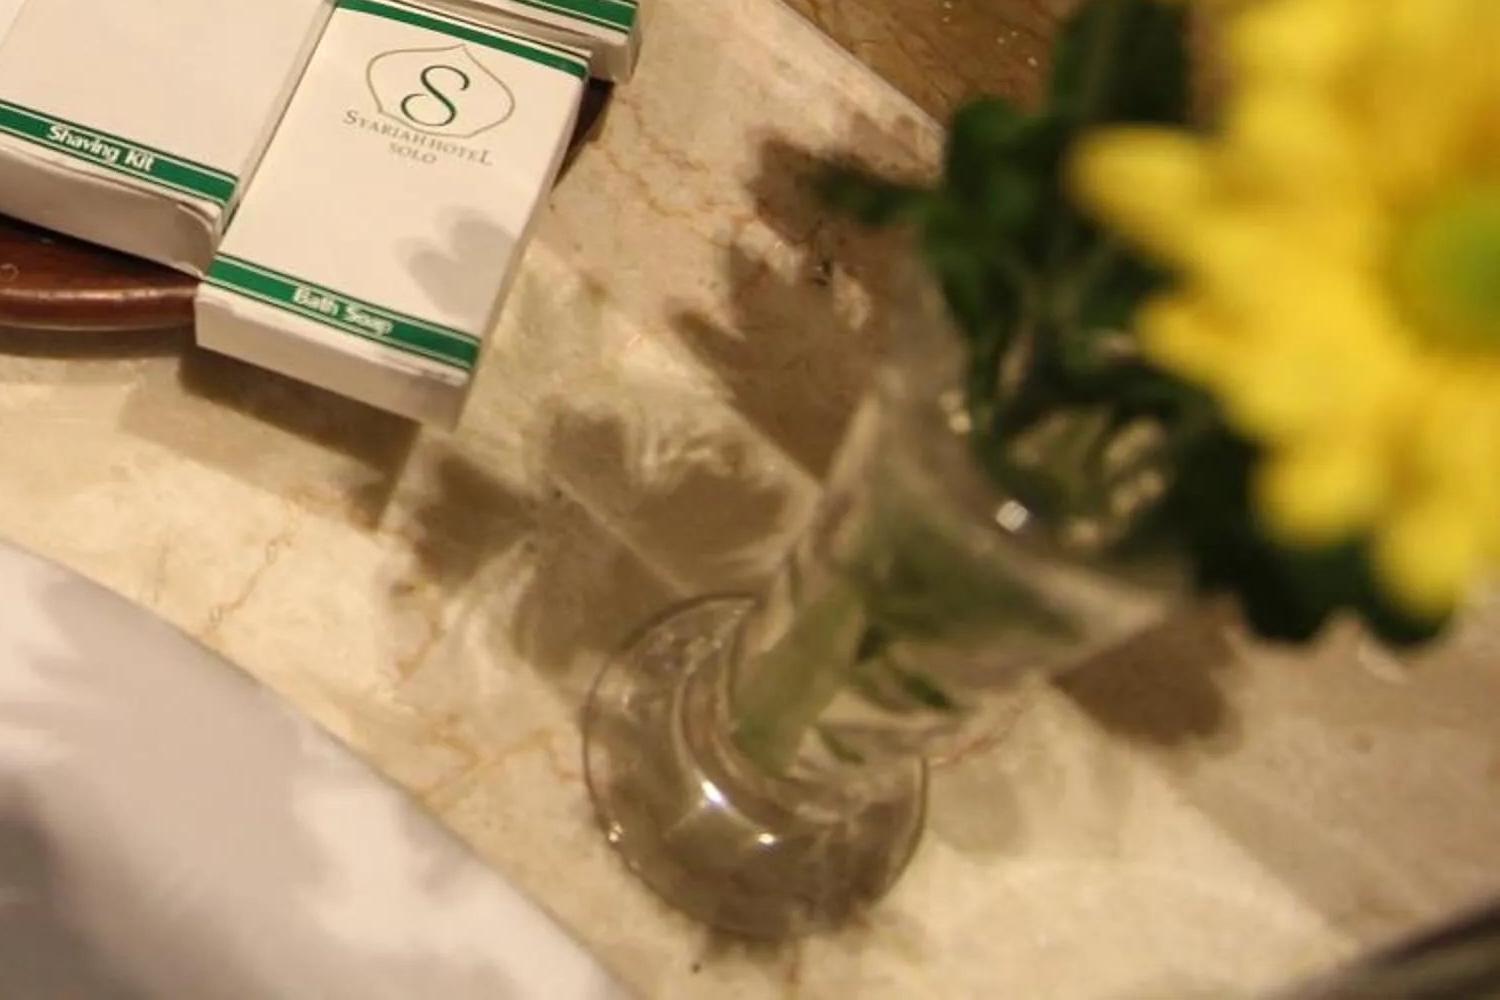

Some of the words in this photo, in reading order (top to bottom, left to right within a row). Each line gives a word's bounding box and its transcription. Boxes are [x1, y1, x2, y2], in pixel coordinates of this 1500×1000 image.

[47, 124, 121, 166] Shaving
[124, 148, 155, 172] Kit
[387, 141, 438, 164] SOLO
[293, 286, 340, 317] Bath
